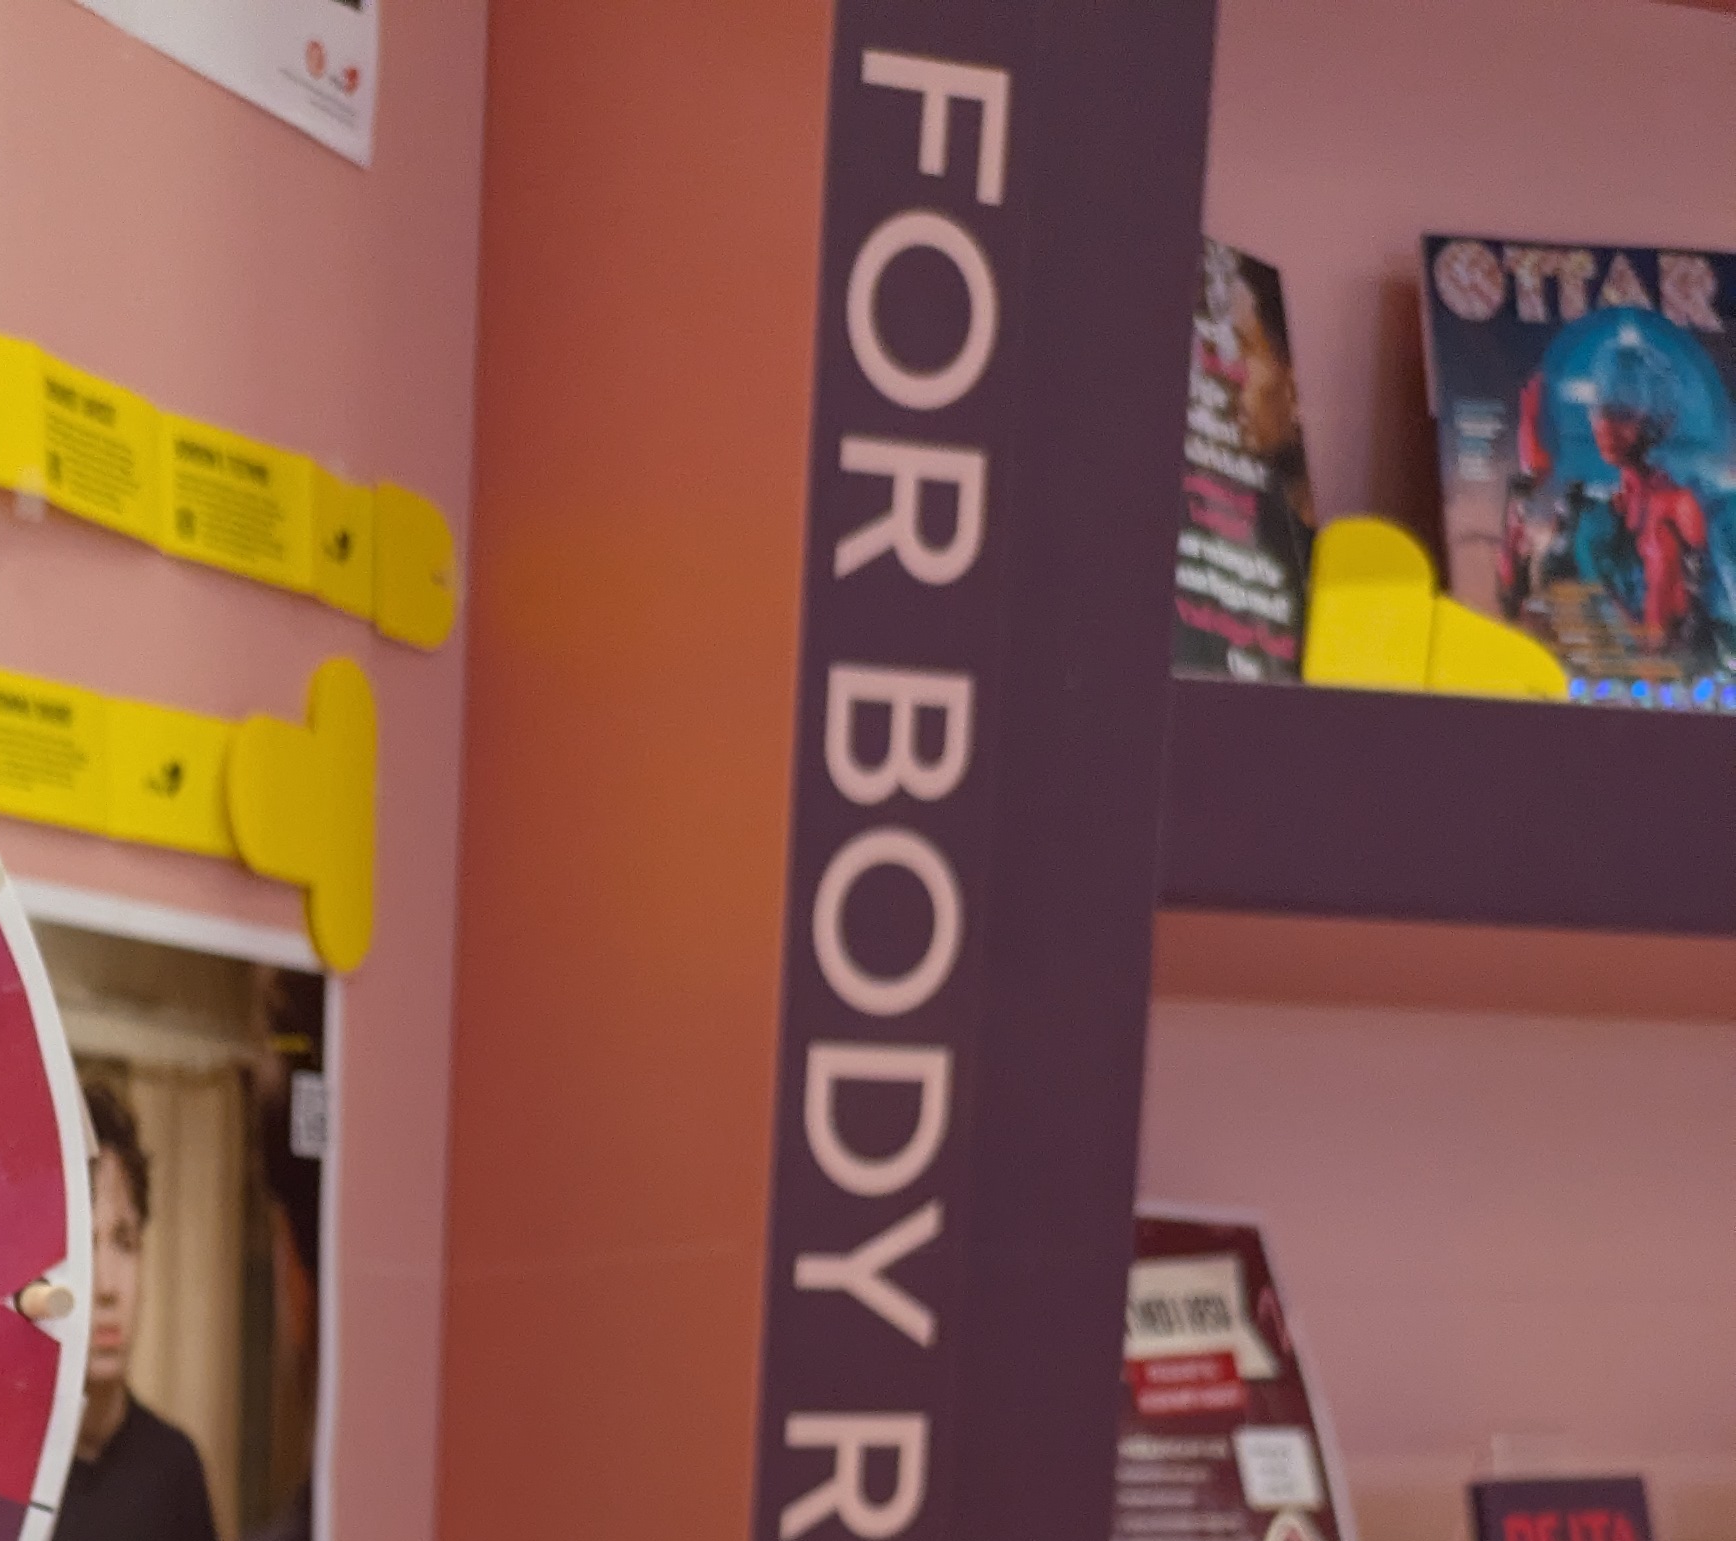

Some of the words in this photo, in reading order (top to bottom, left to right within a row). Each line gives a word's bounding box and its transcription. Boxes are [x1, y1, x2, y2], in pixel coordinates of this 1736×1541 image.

[836, 50, 1010, 584] FOR
[1433, 240, 1725, 332] OTTAR
[795, 664, 972, 1345] BODY
